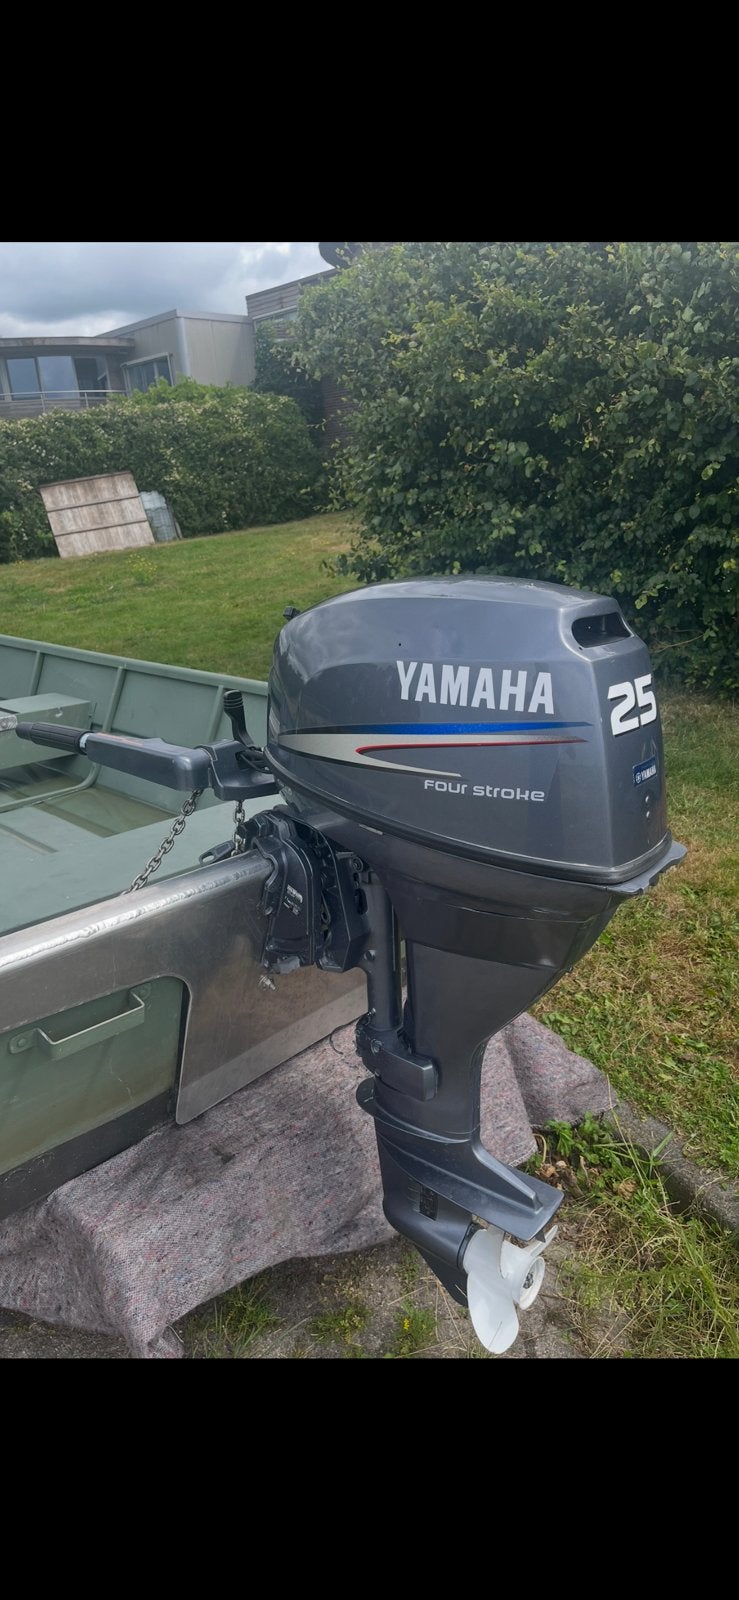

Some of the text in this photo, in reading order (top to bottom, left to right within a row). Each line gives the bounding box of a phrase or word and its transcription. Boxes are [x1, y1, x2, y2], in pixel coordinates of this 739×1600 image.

[396, 660, 555, 715] YAMAHA
[607, 673, 657, 736] 25
[641, 764, 657, 781] YAMAHA
